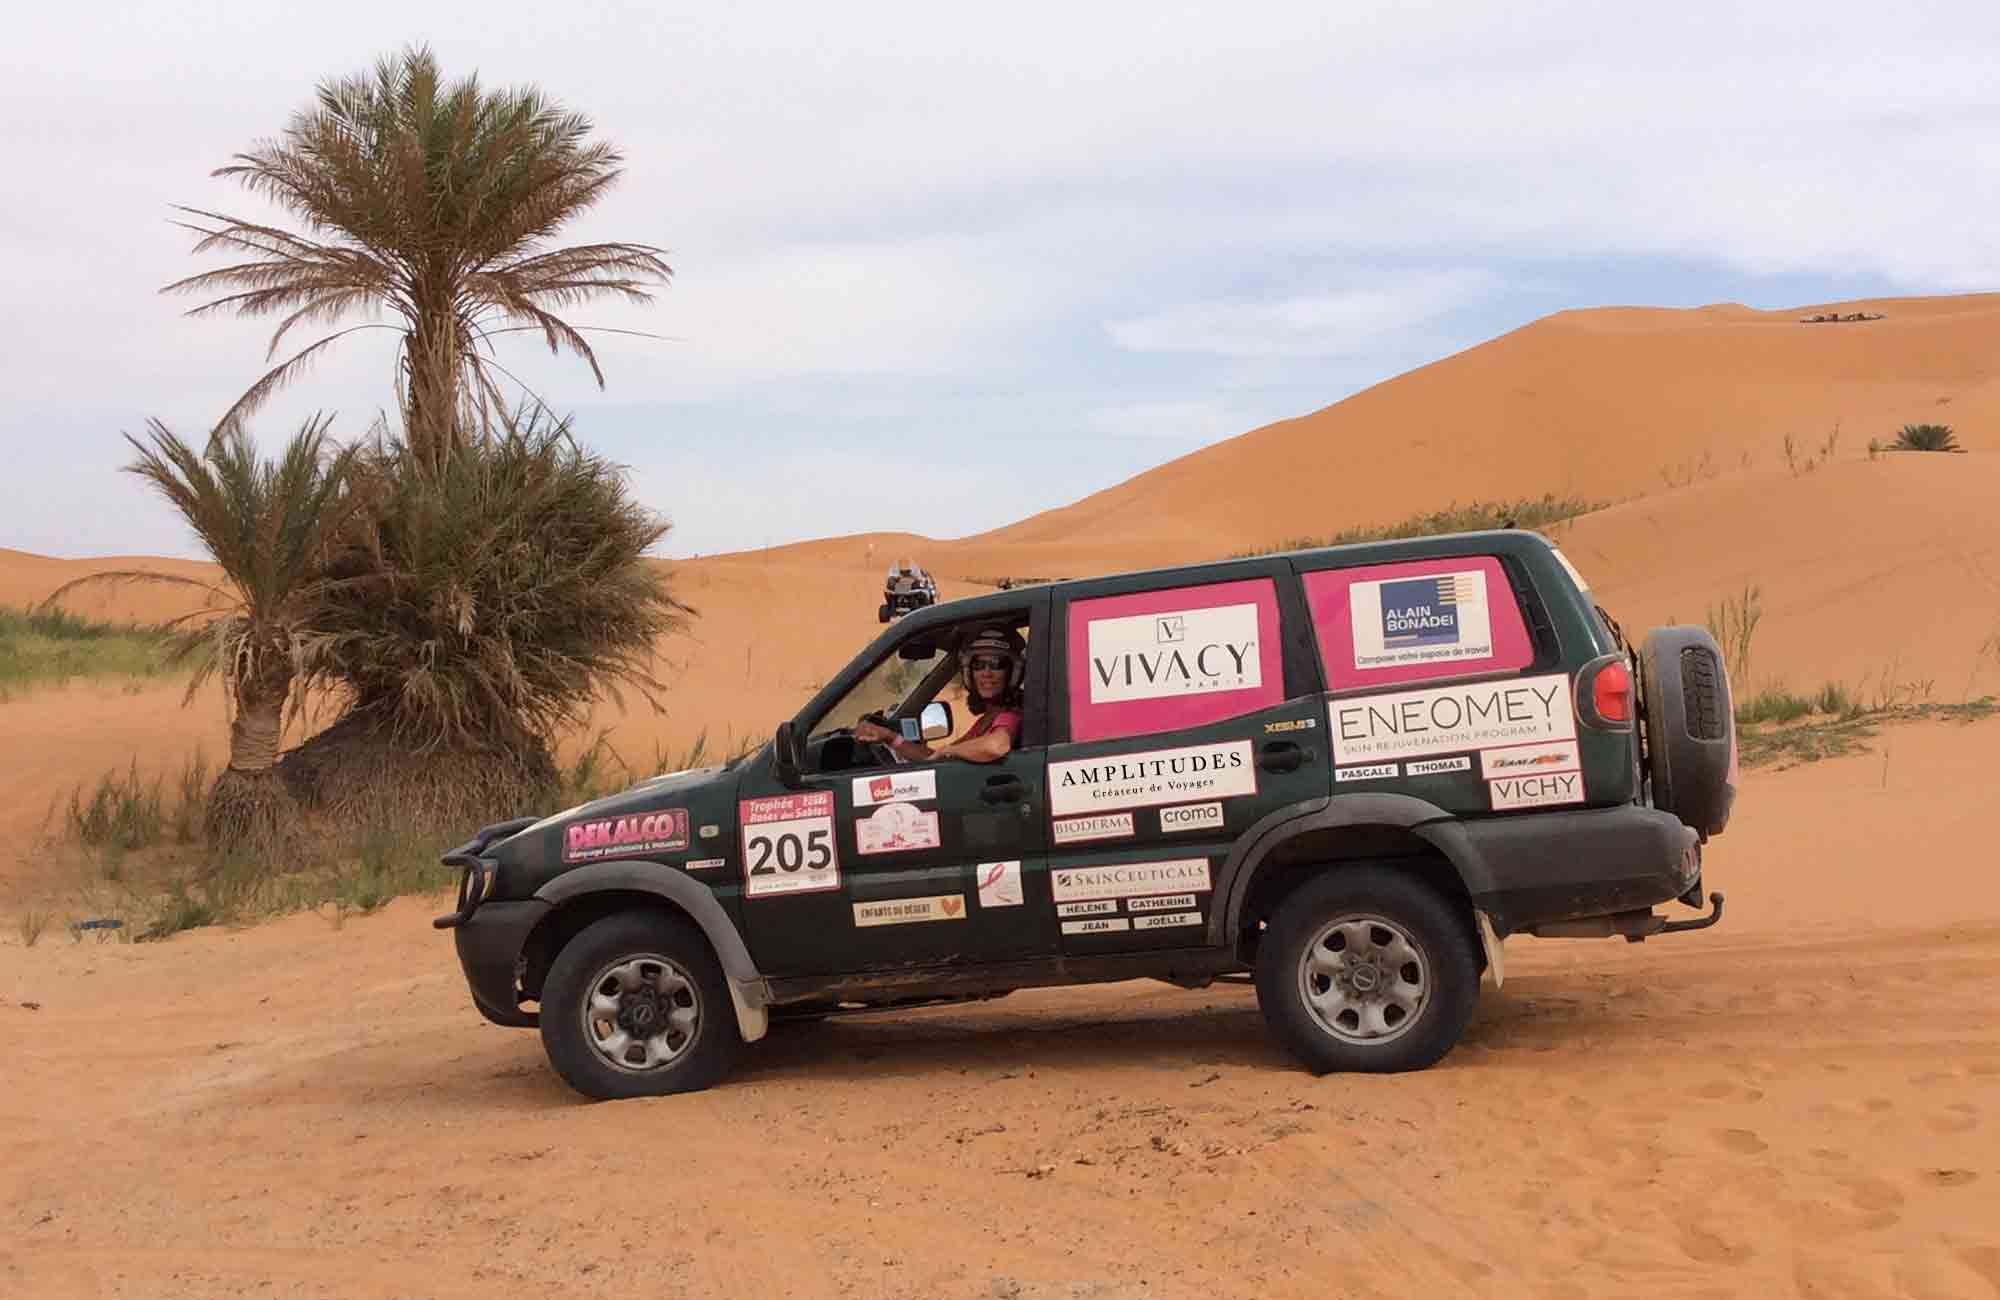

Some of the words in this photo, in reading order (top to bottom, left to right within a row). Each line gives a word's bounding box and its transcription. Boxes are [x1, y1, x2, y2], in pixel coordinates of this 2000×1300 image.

[1386, 605, 1431, 620] ALAIN
[1387, 614, 1454, 632] BONADEI
[1452, 647, 1463, 658] de
[1094, 641, 1249, 688] VIVACY
[1340, 684, 1559, 741] ENEOMEY
[1343, 743, 1372, 755] SKIN
[1375, 733, 1471, 750] REJUVENATION
[1474, 726, 1537, 741] PROGRAM
[1061, 751, 1243, 788] AMPLITUDES
[1341, 767, 1393, 779] PASCALE
[1414, 760, 1464, 773] THOMAS
[1092, 786, 1144, 799] Créateur
[1149, 783, 1163, 793] de
[1168, 778, 1215, 791] Voyages
[1495, 774, 1577, 799] VICHY
[750, 799, 794, 814] Trophée
[1164, 806, 1218, 823] croma
[568, 814, 674, 848] DEKALCO
[1055, 816, 1131, 834] BIODERMA
[749, 829, 831, 876] 205
[1131, 897, 1192, 908] CATHERINE
[1081, 920, 1109, 931] JEAN
